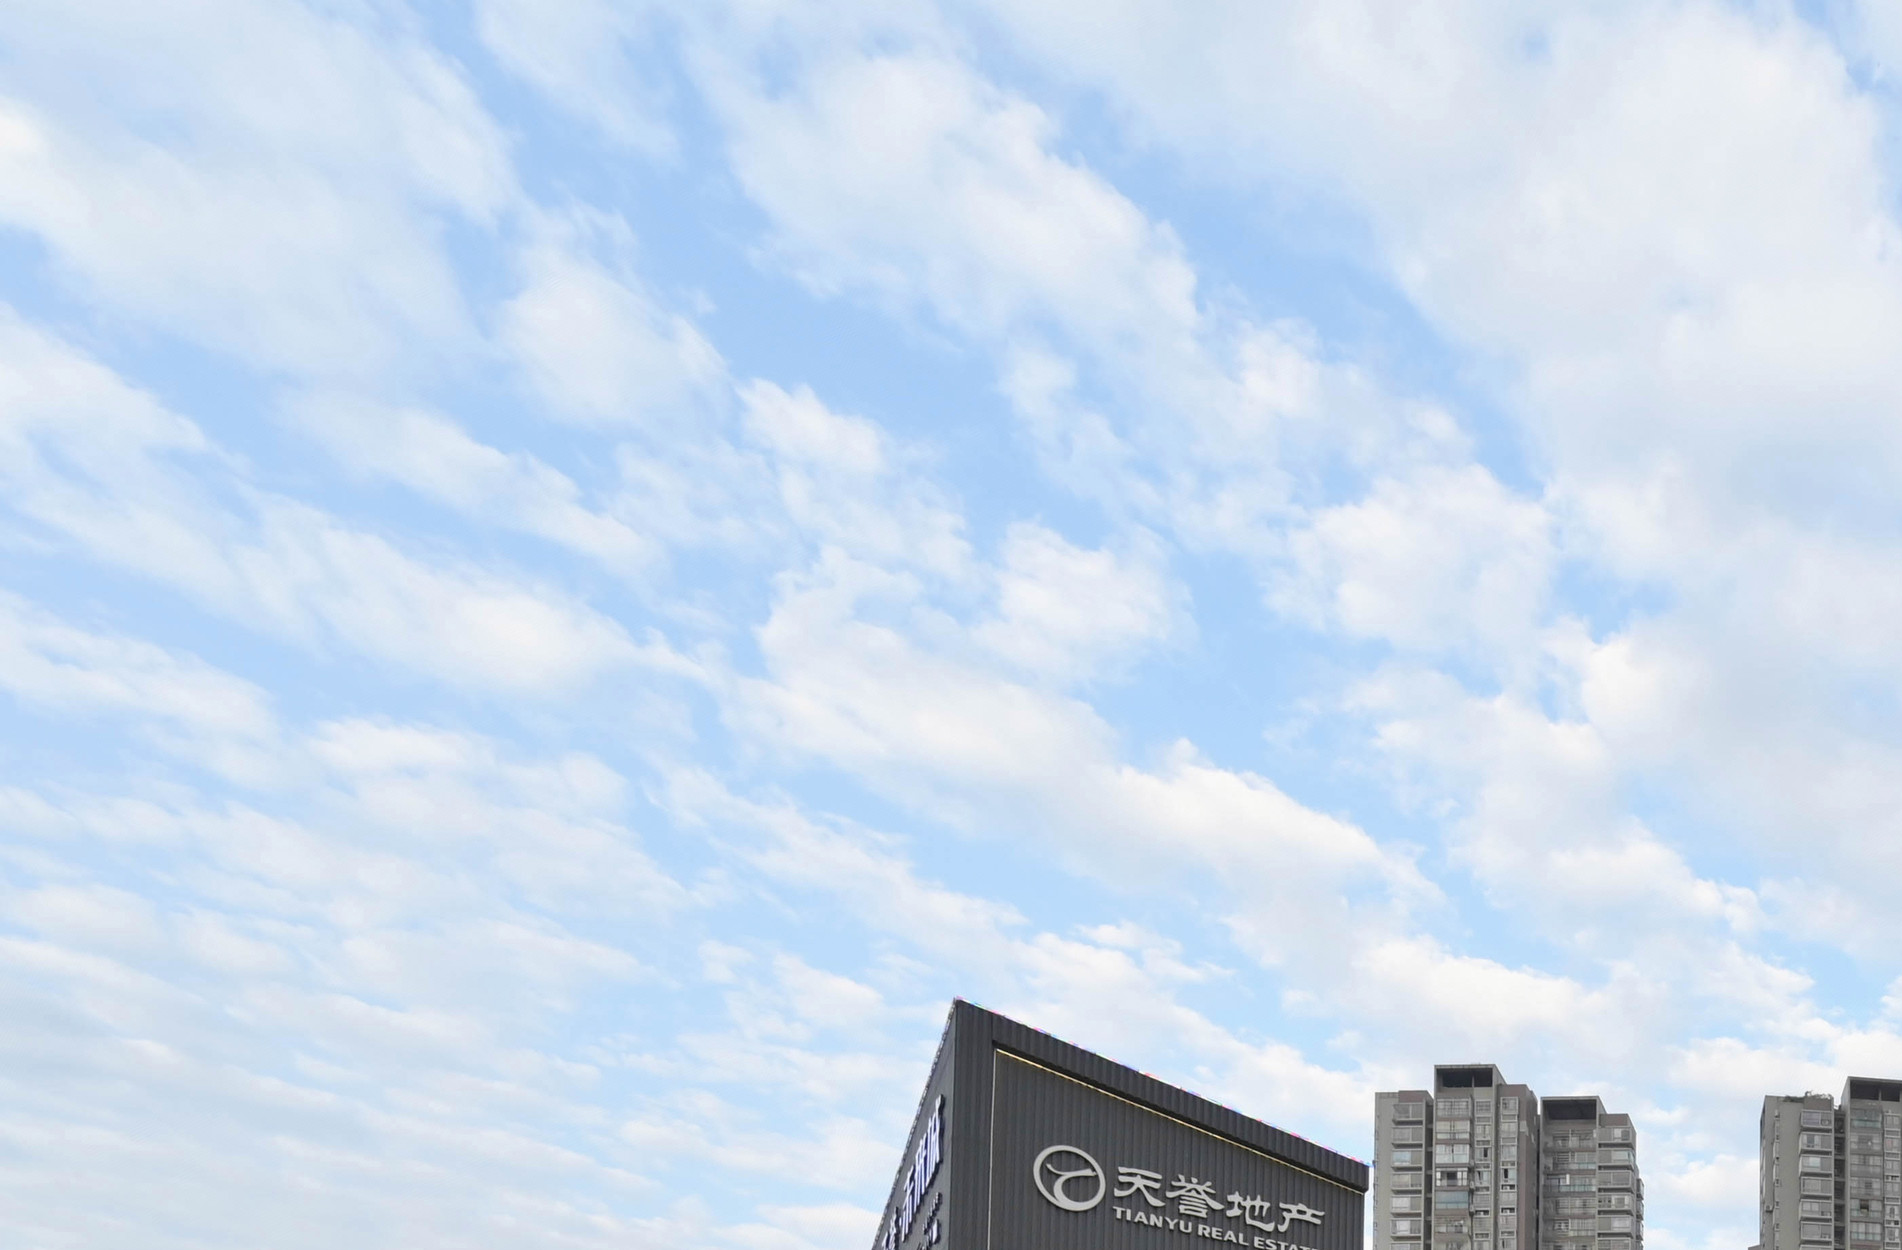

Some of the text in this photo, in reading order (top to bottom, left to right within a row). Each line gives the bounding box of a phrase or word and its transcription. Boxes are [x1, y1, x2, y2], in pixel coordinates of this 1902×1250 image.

[1114, 1166, 1325, 1232] 天誉地产
[1113, 1206, 1193, 1234] TIANYU
[1198, 1224, 1249, 1247] REAL
